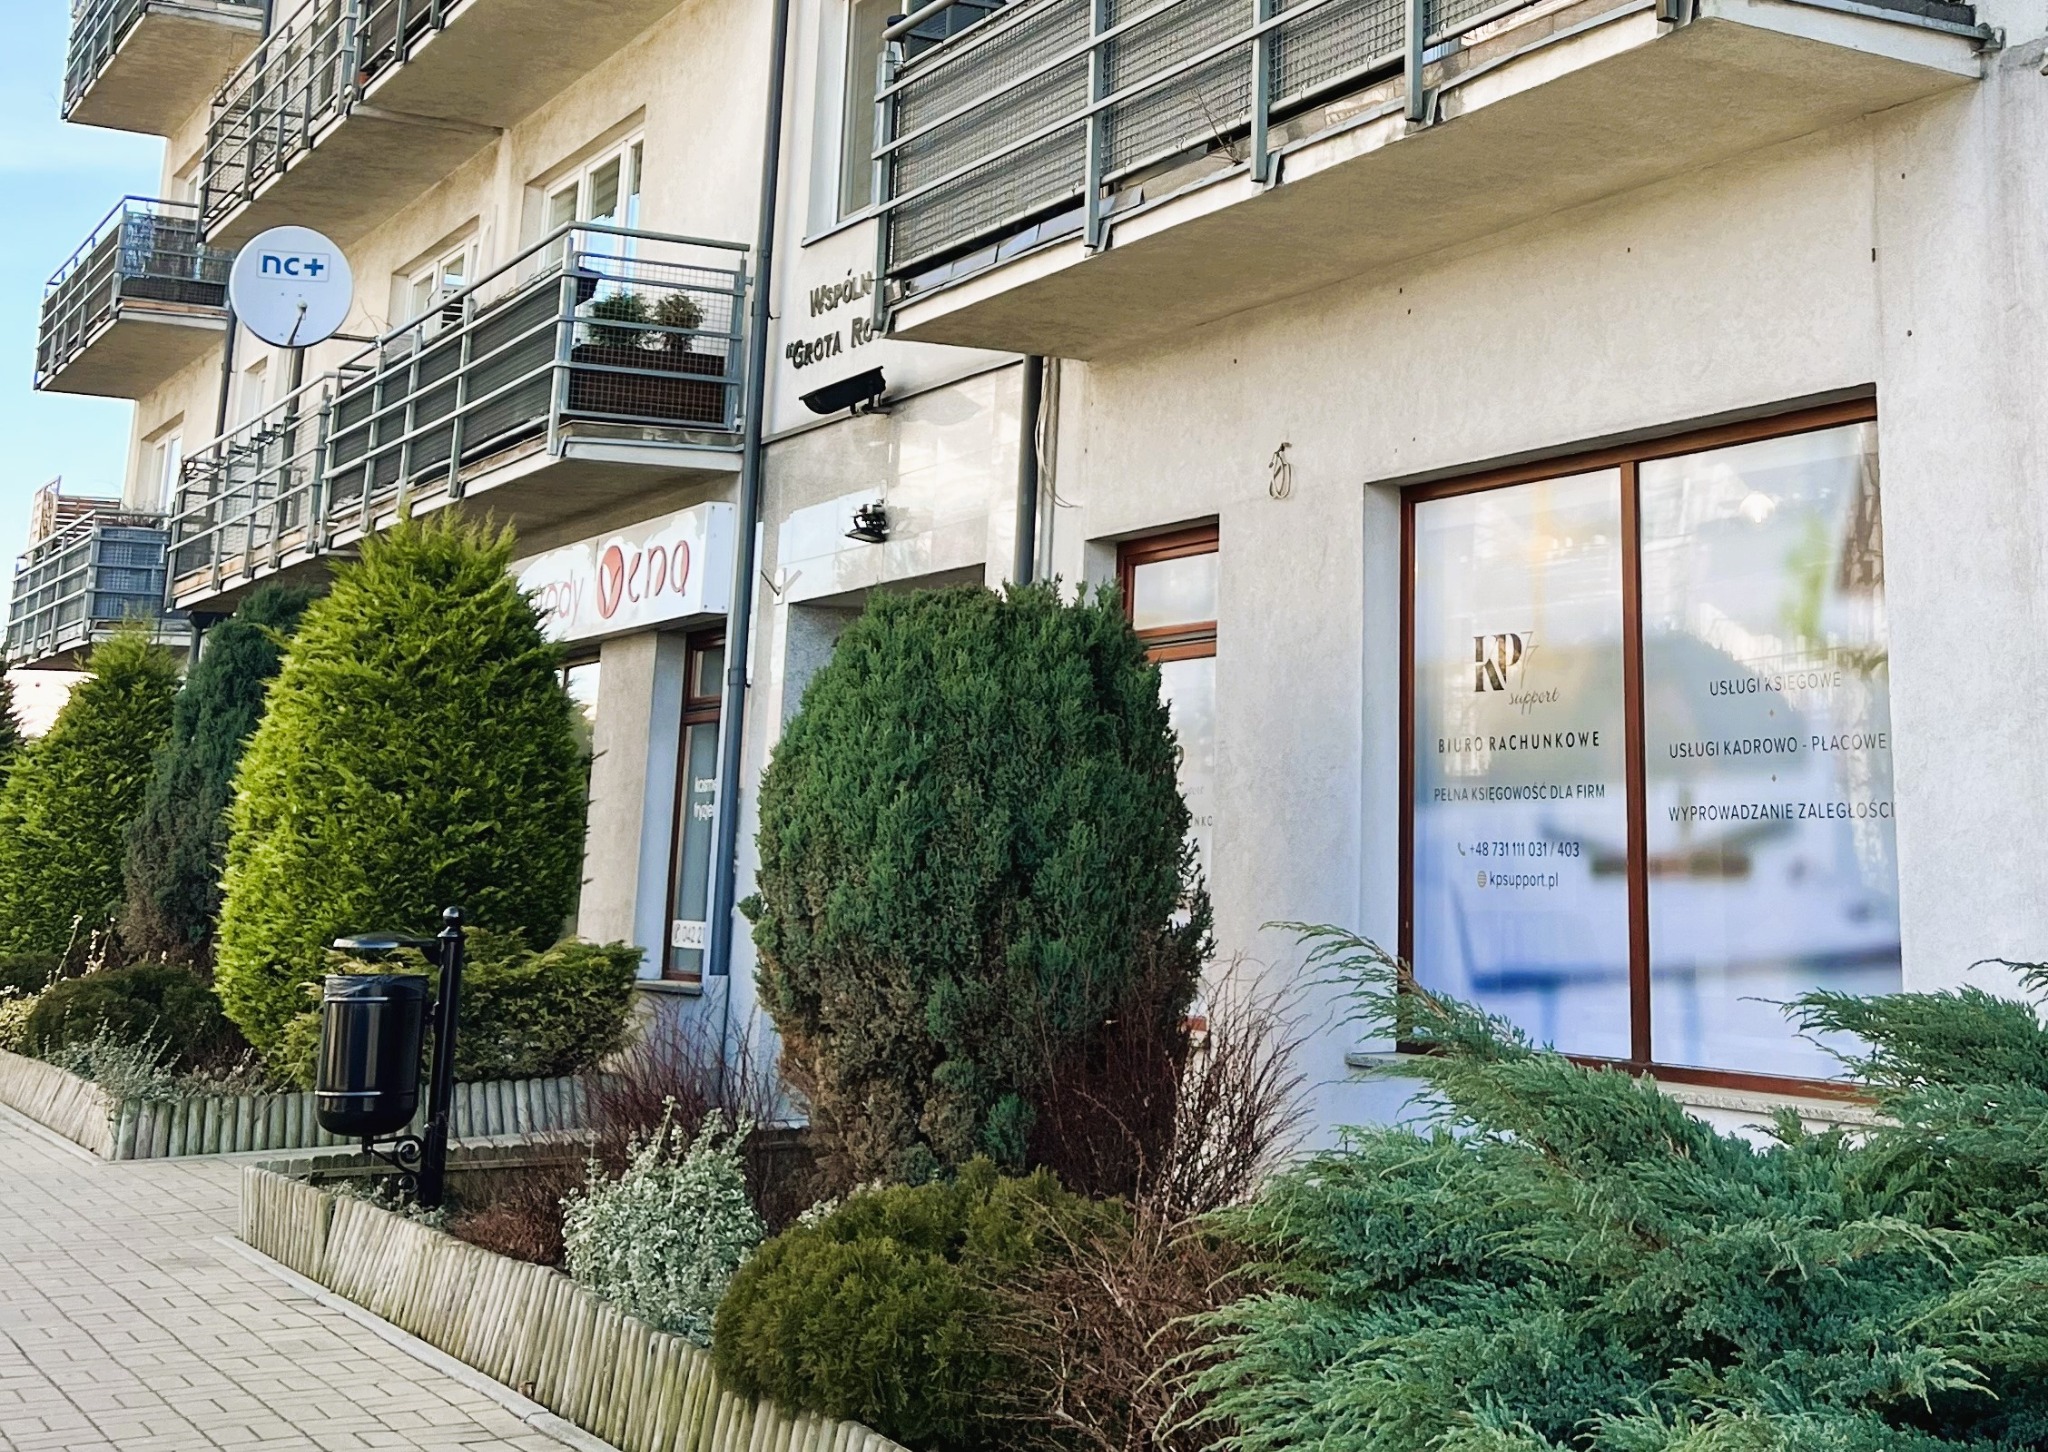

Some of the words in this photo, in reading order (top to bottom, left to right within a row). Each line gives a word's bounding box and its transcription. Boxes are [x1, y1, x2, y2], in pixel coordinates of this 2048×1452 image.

[262, 255, 324, 276] nc+
[1709, 677, 1760, 696] USŁUGI
[1509, 687, 1560, 715] support
[1438, 736, 1484, 753] BIURO
[1489, 731, 1600, 751] RACHUNKOWE
[1669, 741, 1720, 758] USŁUGI
[1723, 737, 1798, 755] KADROWO
[1811, 733, 1887, 751] PŁACOWE
[1434, 787, 1469, 802] PEŁNA
[1471, 782, 1547, 804] KSIĘGOWOŚĆ
[1550, 785, 1573, 799] DLA
[1576, 784, 1605, 798] FIRM
[1669, 804, 1793, 821] WYPROWADZANIE
[1798, 798, 1895, 819] ZALEGŁOŚCI
[1470, 842, 1489, 857] +48
[1492, 842, 1509, 857] 731
[1512, 842, 1525, 857] 111
[1528, 842, 1548, 857] 031
[1557, 842, 1580, 857] 403
[1489, 871, 1559, 890] kpsupport.pl
